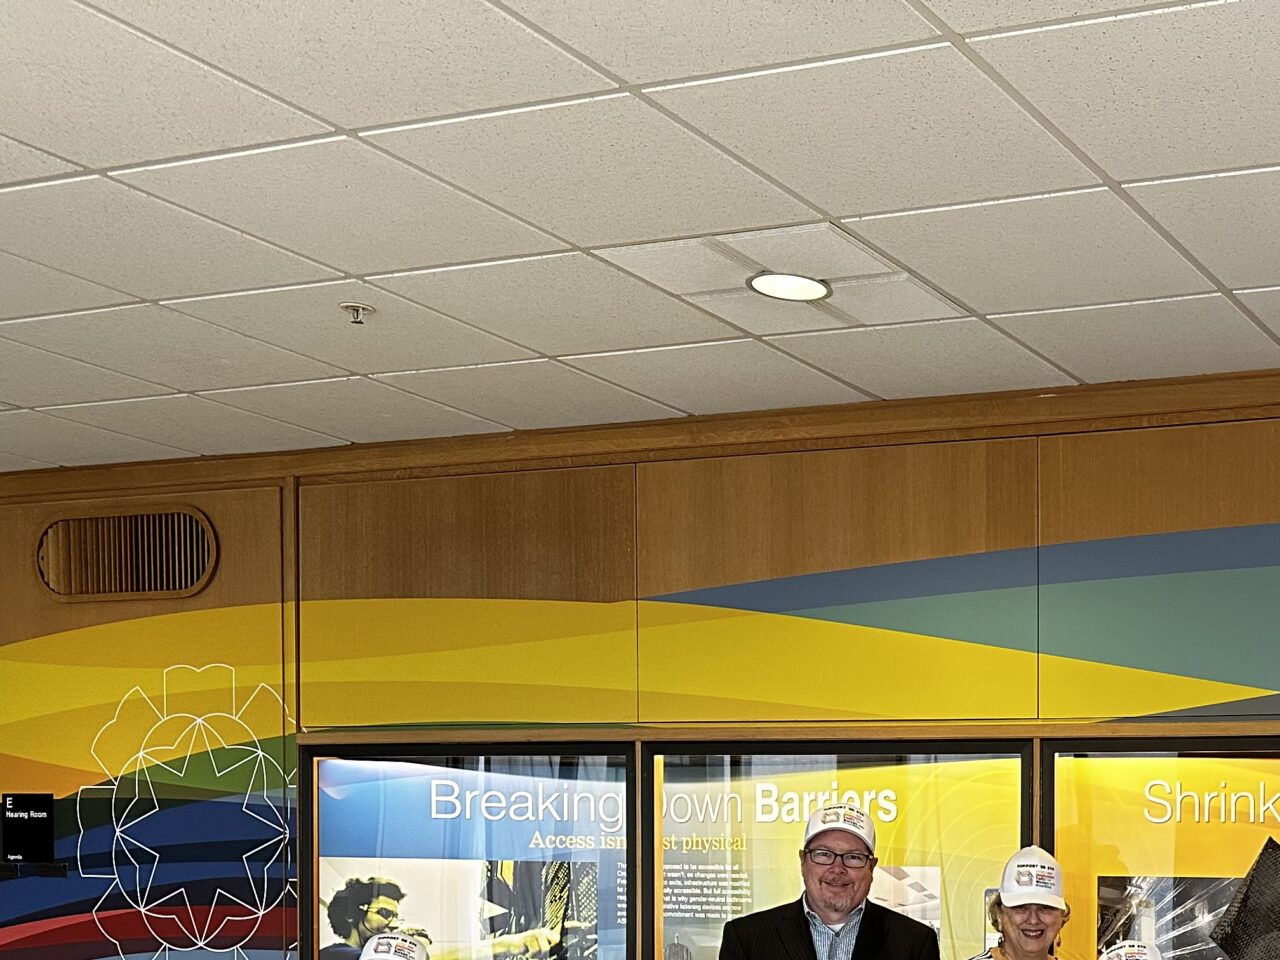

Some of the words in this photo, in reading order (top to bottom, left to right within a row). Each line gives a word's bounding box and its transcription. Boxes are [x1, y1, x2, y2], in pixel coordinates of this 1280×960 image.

[7, 797, 13, 808] E
[431, 780, 624, 832] Breaking
[6, 811, 28, 819] Hearing
[529, 832, 595, 848] Access
[600, 832, 626, 849] isn
[663, 835, 677, 850] st
[682, 833, 747, 854] physical
